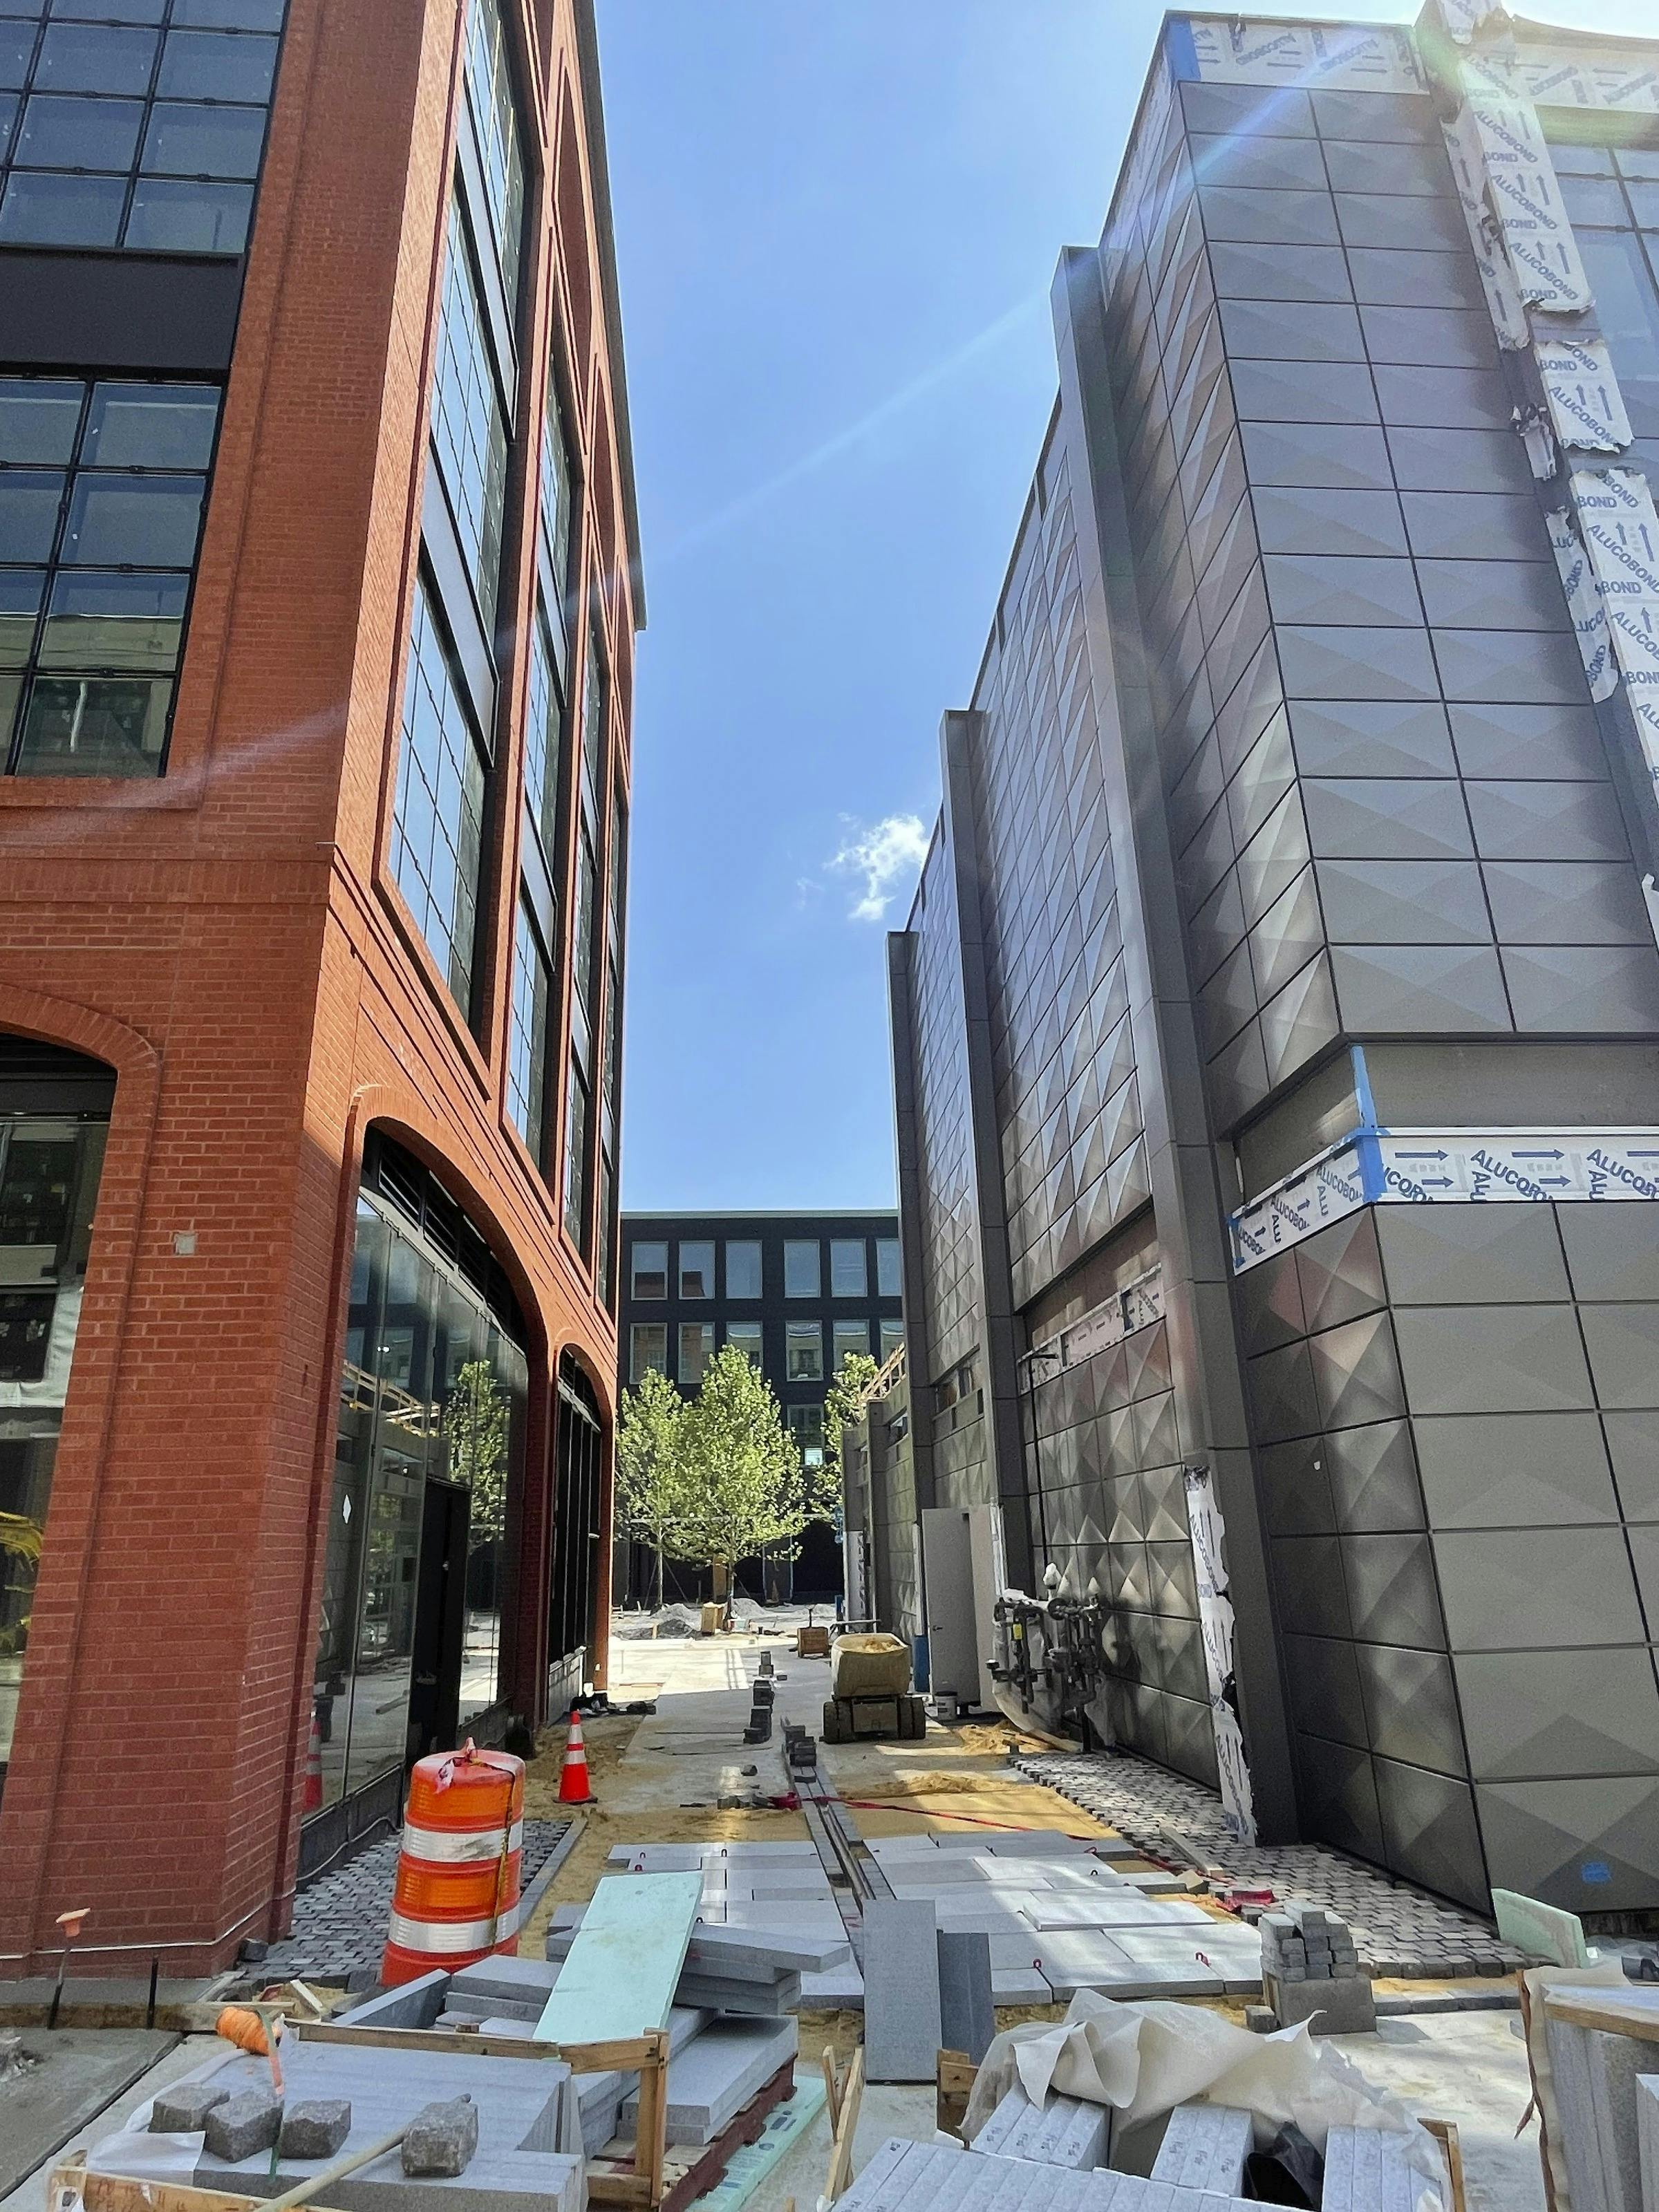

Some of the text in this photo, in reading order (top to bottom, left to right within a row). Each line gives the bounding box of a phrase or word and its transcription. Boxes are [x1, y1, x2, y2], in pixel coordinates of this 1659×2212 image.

[1474, 111, 1538, 162] ALUCOBOND
[1491, 174, 1557, 229] ALUCOBOND
[1510, 243, 1579, 300] ALUCOBOND
[1540, 359, 1577, 371] BOND
[1577, 496, 1618, 508] BOND
[1599, 581, 1642, 594] BOND
